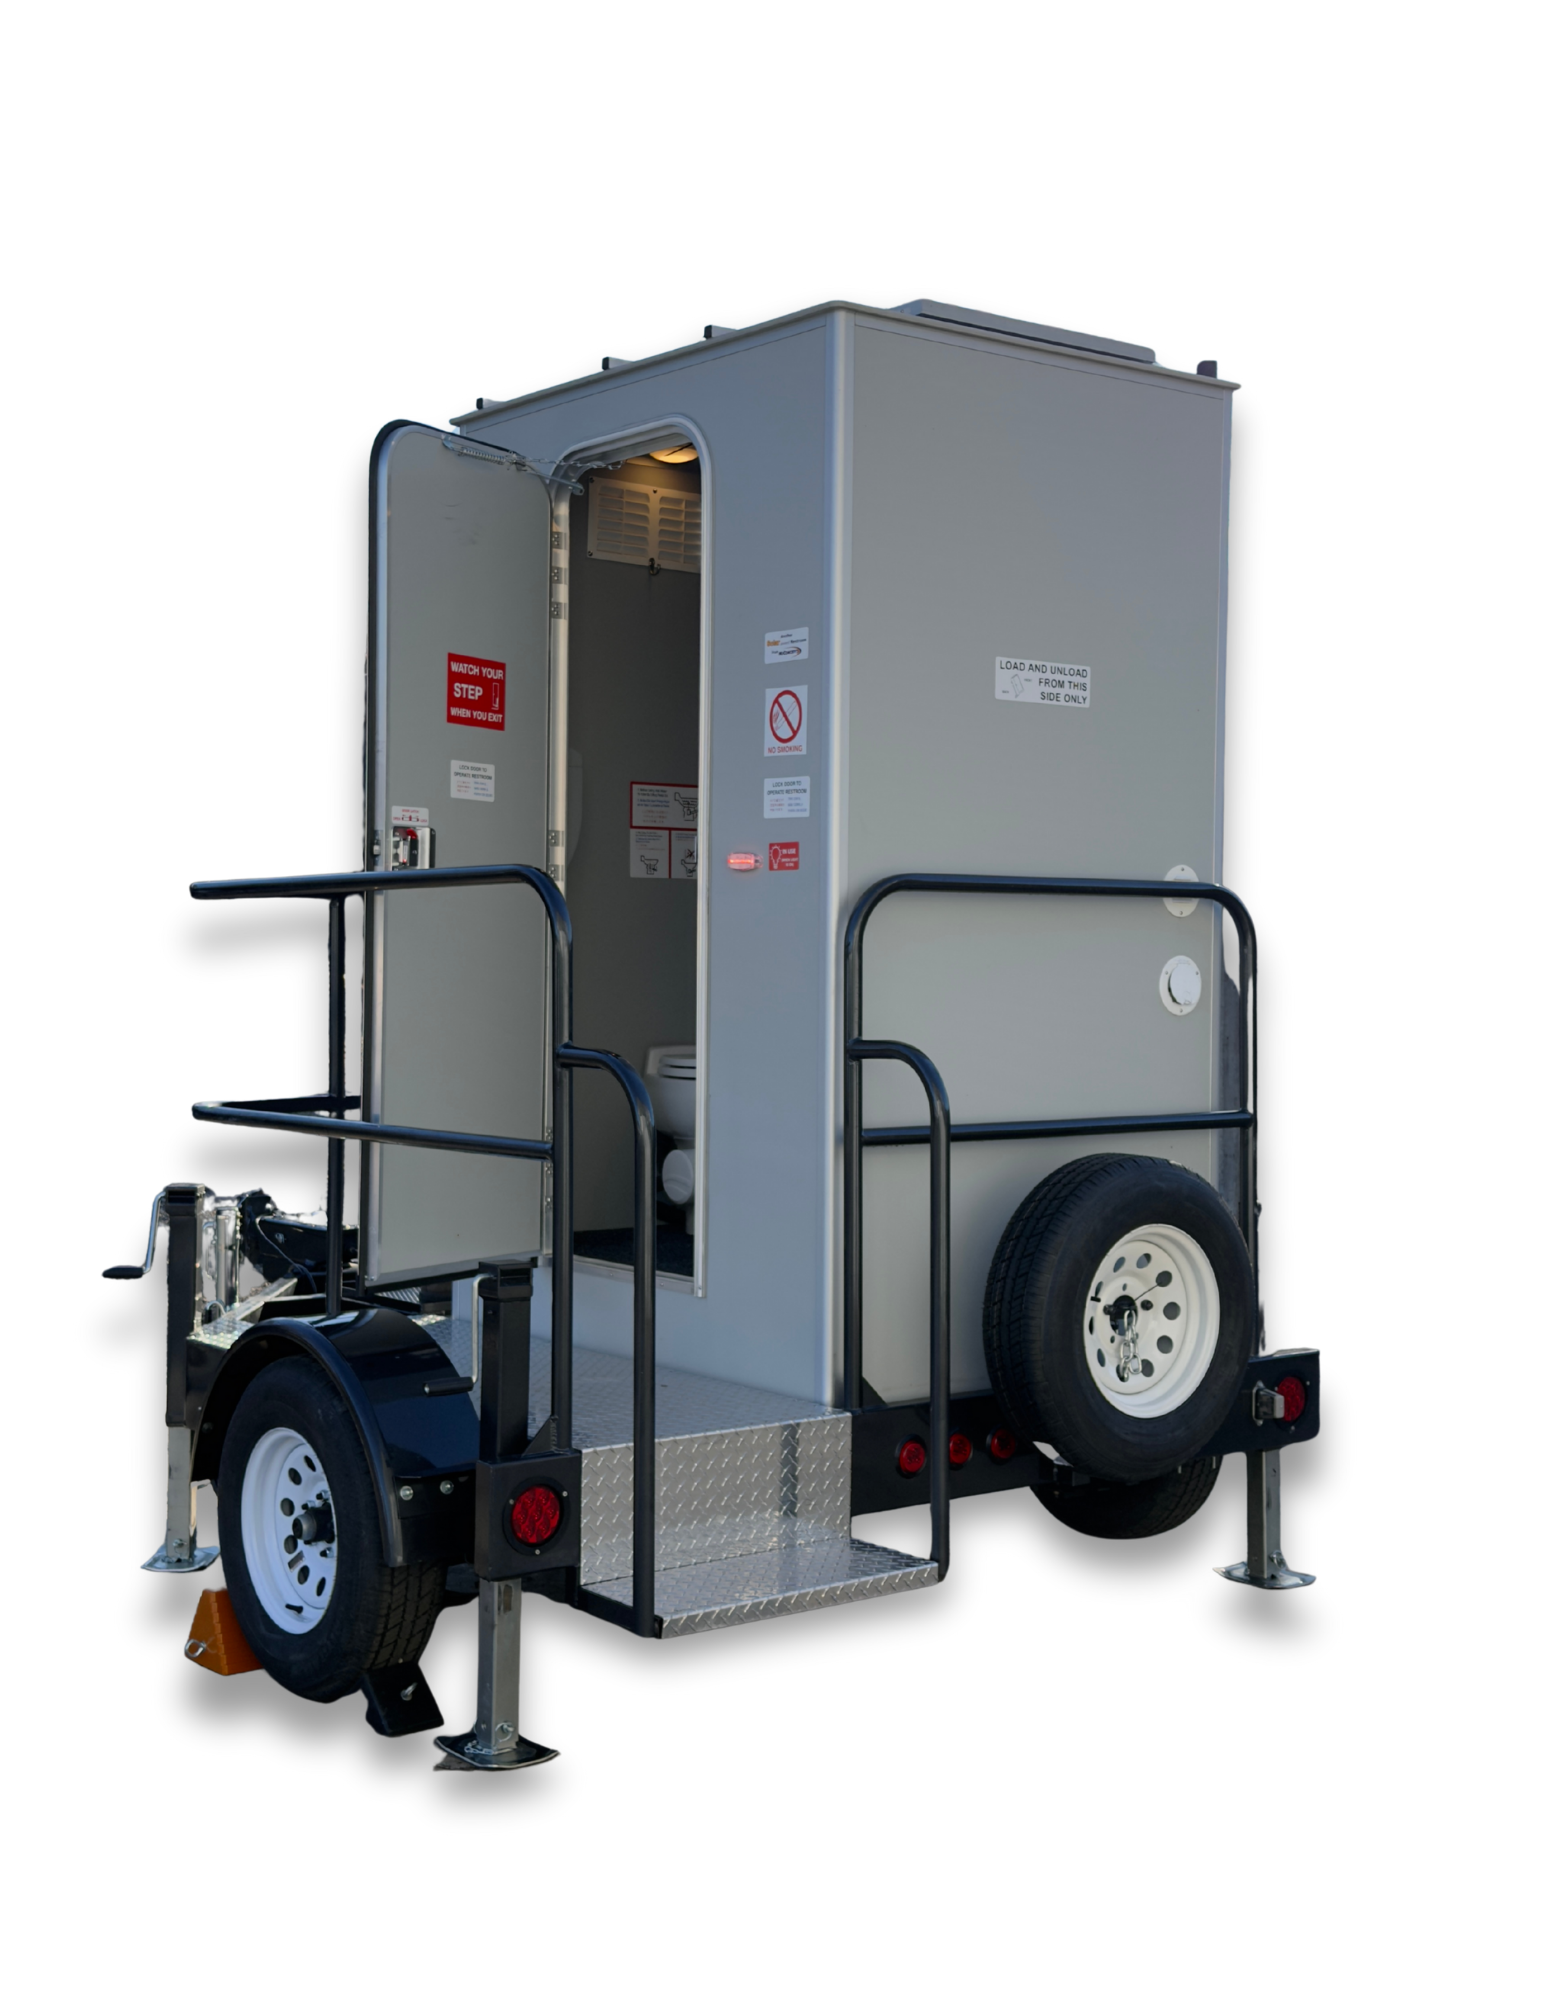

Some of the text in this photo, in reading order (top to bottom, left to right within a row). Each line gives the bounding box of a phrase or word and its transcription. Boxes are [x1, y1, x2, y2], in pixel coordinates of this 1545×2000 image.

[450, 661, 504, 680] WATCH YOUR
[1000, 660, 1088, 678] LOAD AND UNLOAD
[454, 682, 483, 700] STEP
[1038, 678, 1087, 692] FROM THIS
[1040, 692, 1087, 704] SIDE ONLY
[450, 706, 503, 723] WHEN YOU EXIT
[777, 745, 802, 753] SMOKING
